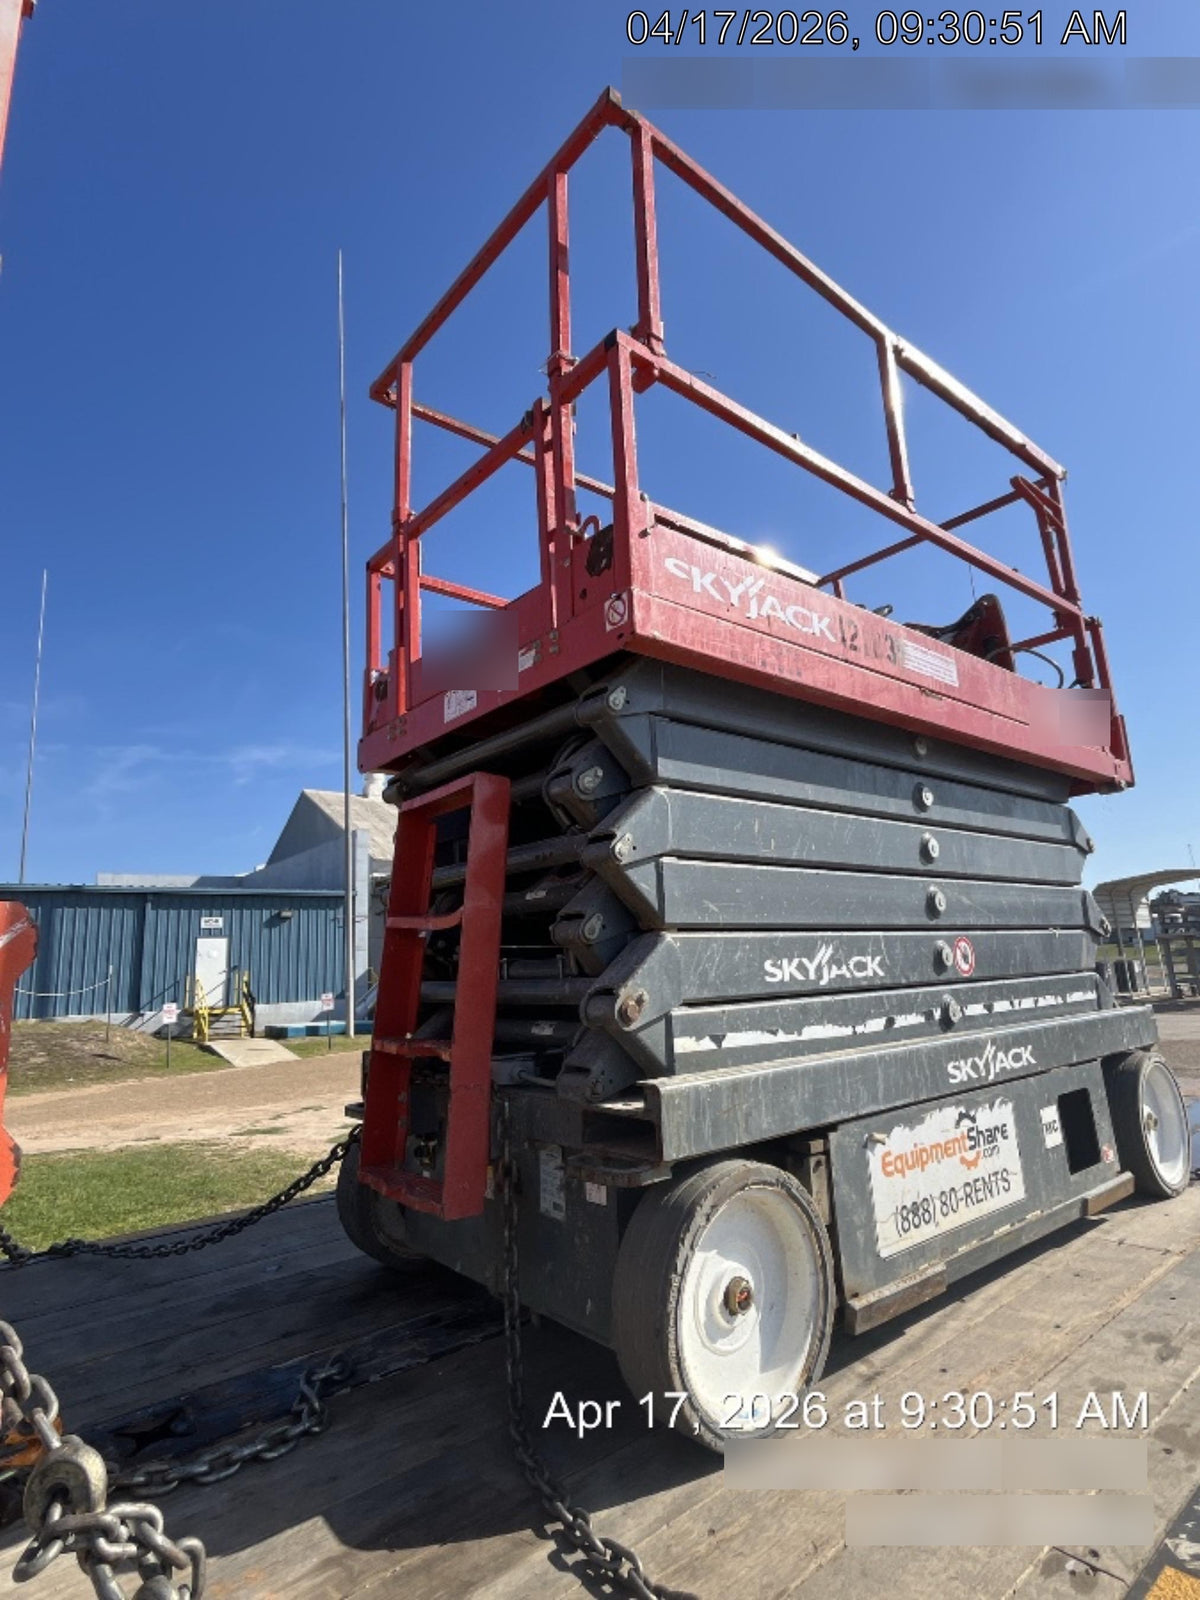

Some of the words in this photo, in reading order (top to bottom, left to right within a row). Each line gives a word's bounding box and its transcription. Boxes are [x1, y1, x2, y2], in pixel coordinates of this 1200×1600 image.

[664, 557, 836, 642] SKYJACK
[763, 943, 885, 986] SKYJACK
[947, 1040, 1037, 1084] SKYJACK
